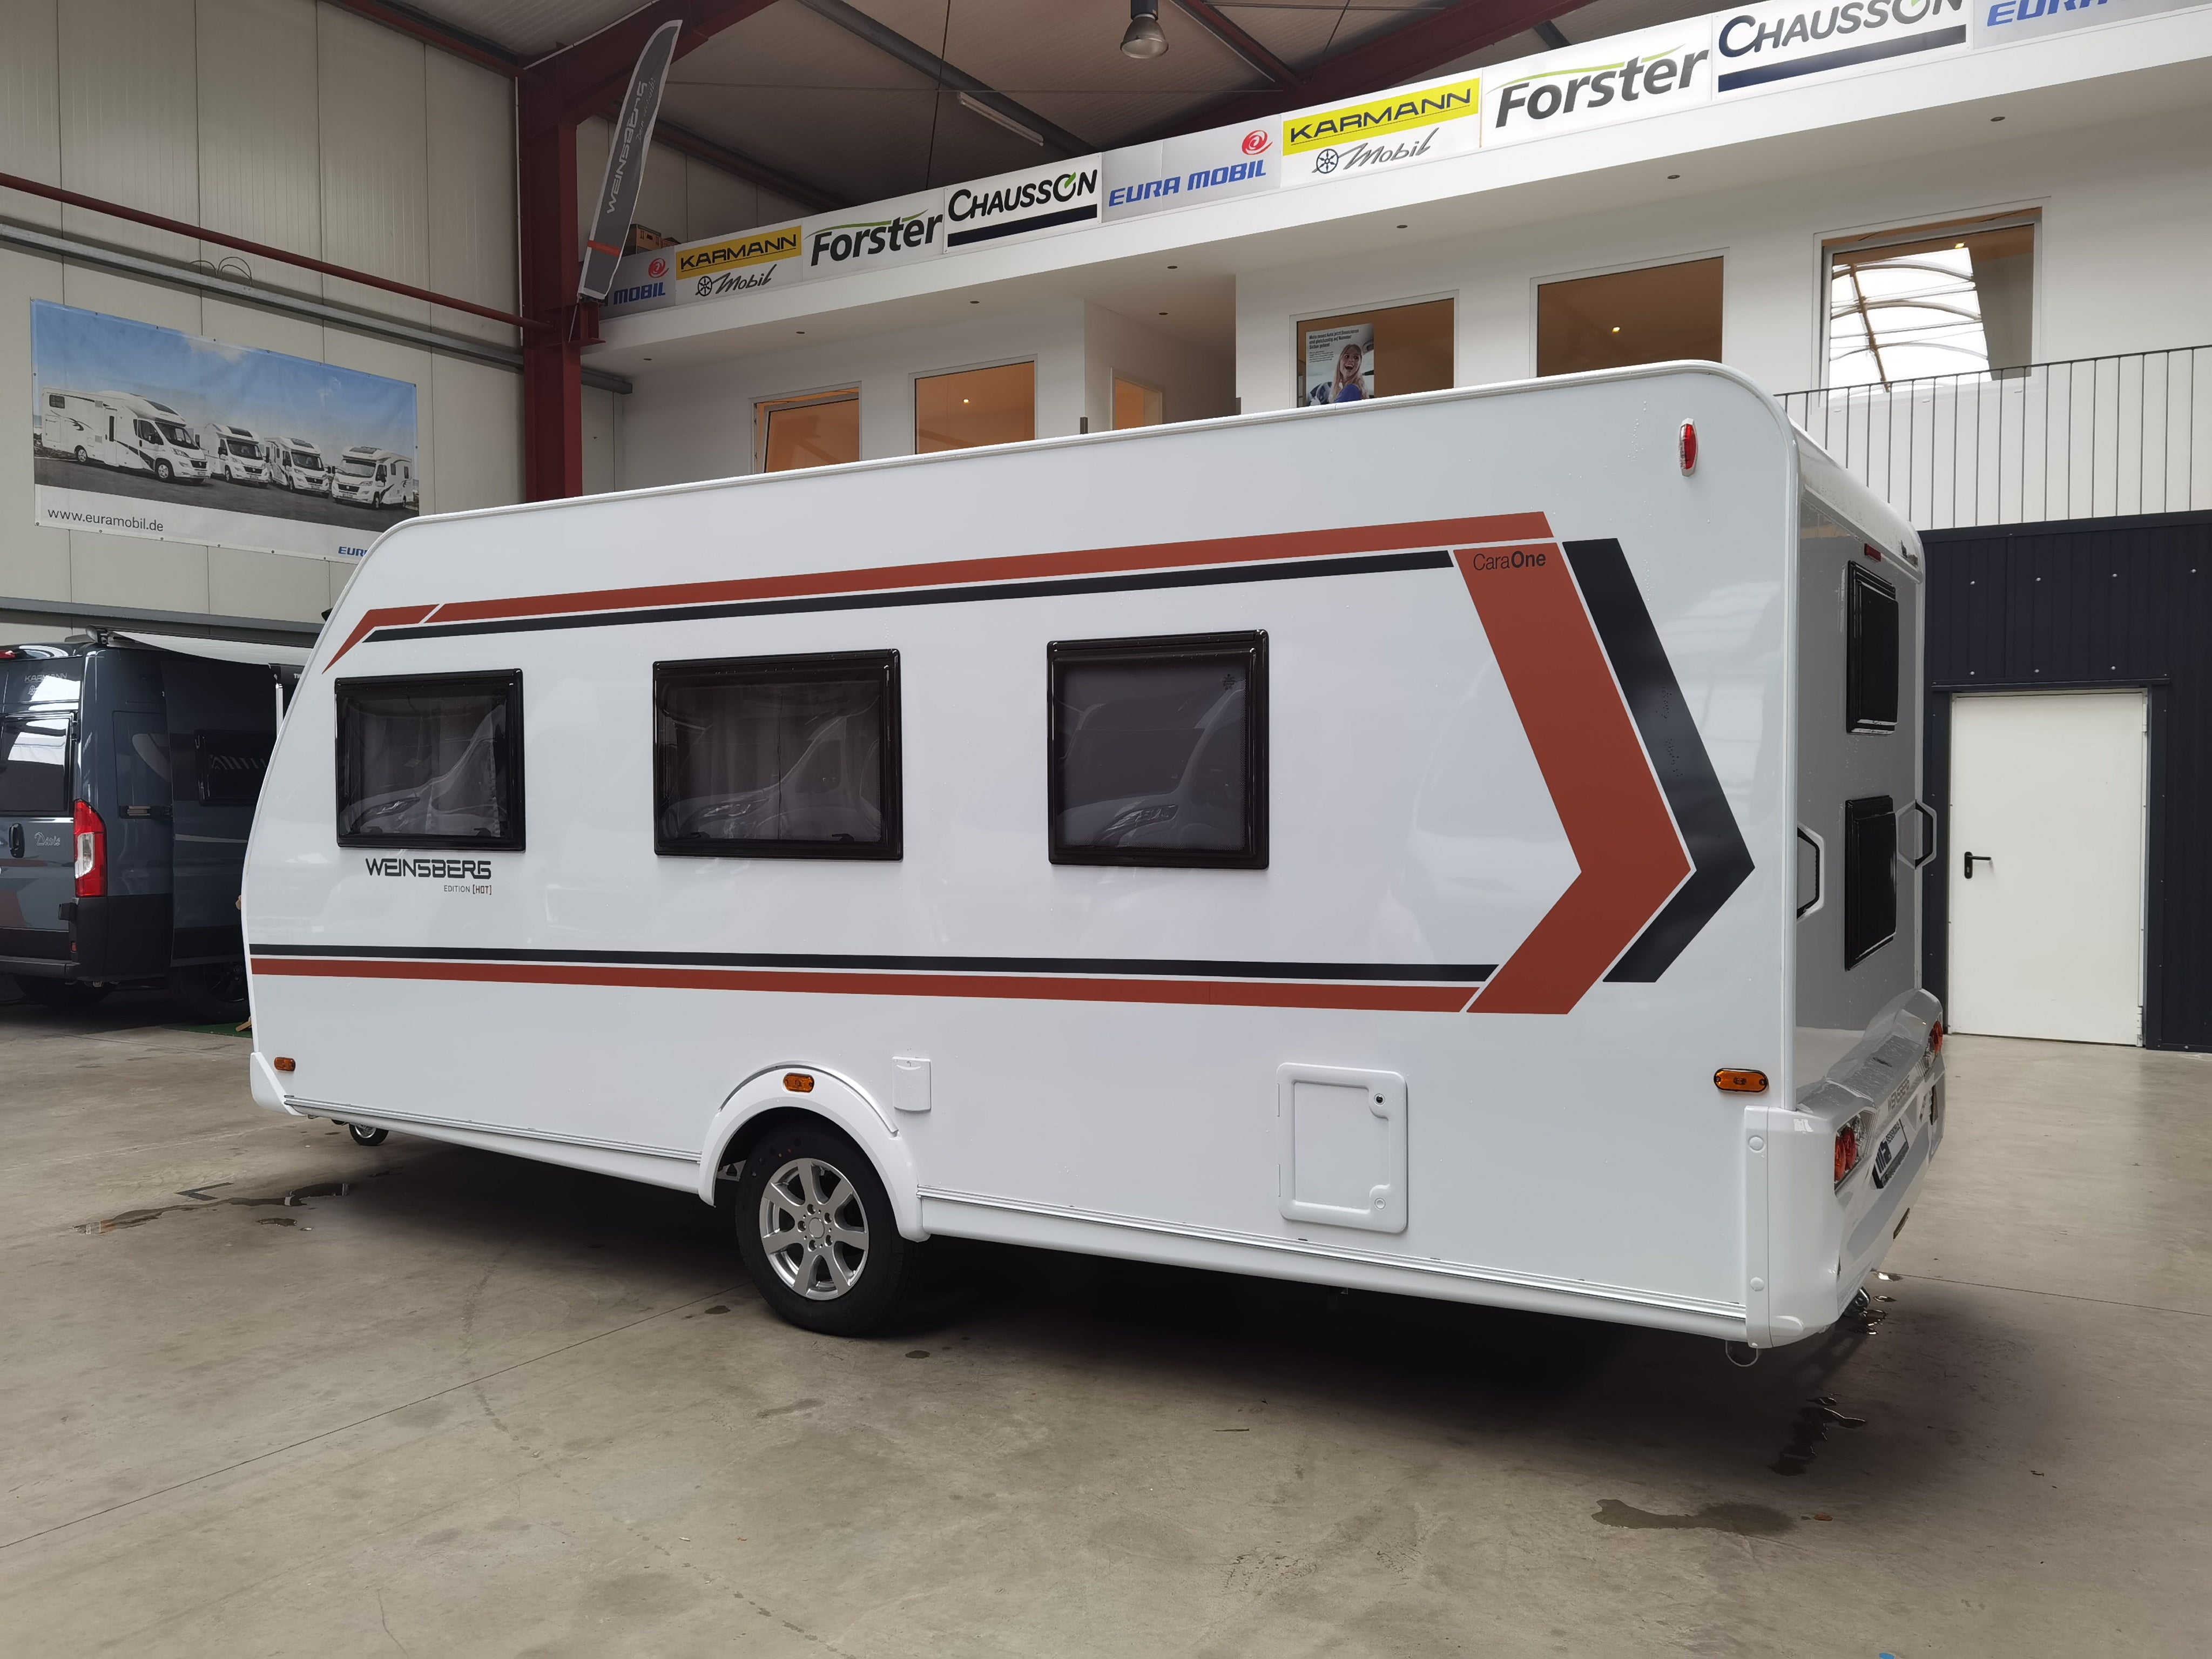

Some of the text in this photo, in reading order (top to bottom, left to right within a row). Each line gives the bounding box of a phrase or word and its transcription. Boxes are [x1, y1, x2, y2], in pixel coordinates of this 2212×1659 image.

[1987, 0, 2107, 27] EUR
[1495, 49, 1710, 129] Forster
[1291, 88, 1471, 143] KARMANN
[1338, 127, 1440, 170] Mobil
[948, 169, 1098, 221] CHAUSSON
[1109, 159, 1266, 207] EURA MOBIL
[681, 234, 797, 270] KARMANN
[811, 214, 943, 267] Forster
[613, 282, 666, 305] MOBIL
[712, 264, 777, 294] Mobil
[48, 509, 164, 531] www.euramobil.de
[1473, 551, 1546, 570] CaraOne
[24, 673, 68, 682] KARNN
[365, 858, 491, 879] WEINSBERG
[444, 885, 470, 893] EDITION
